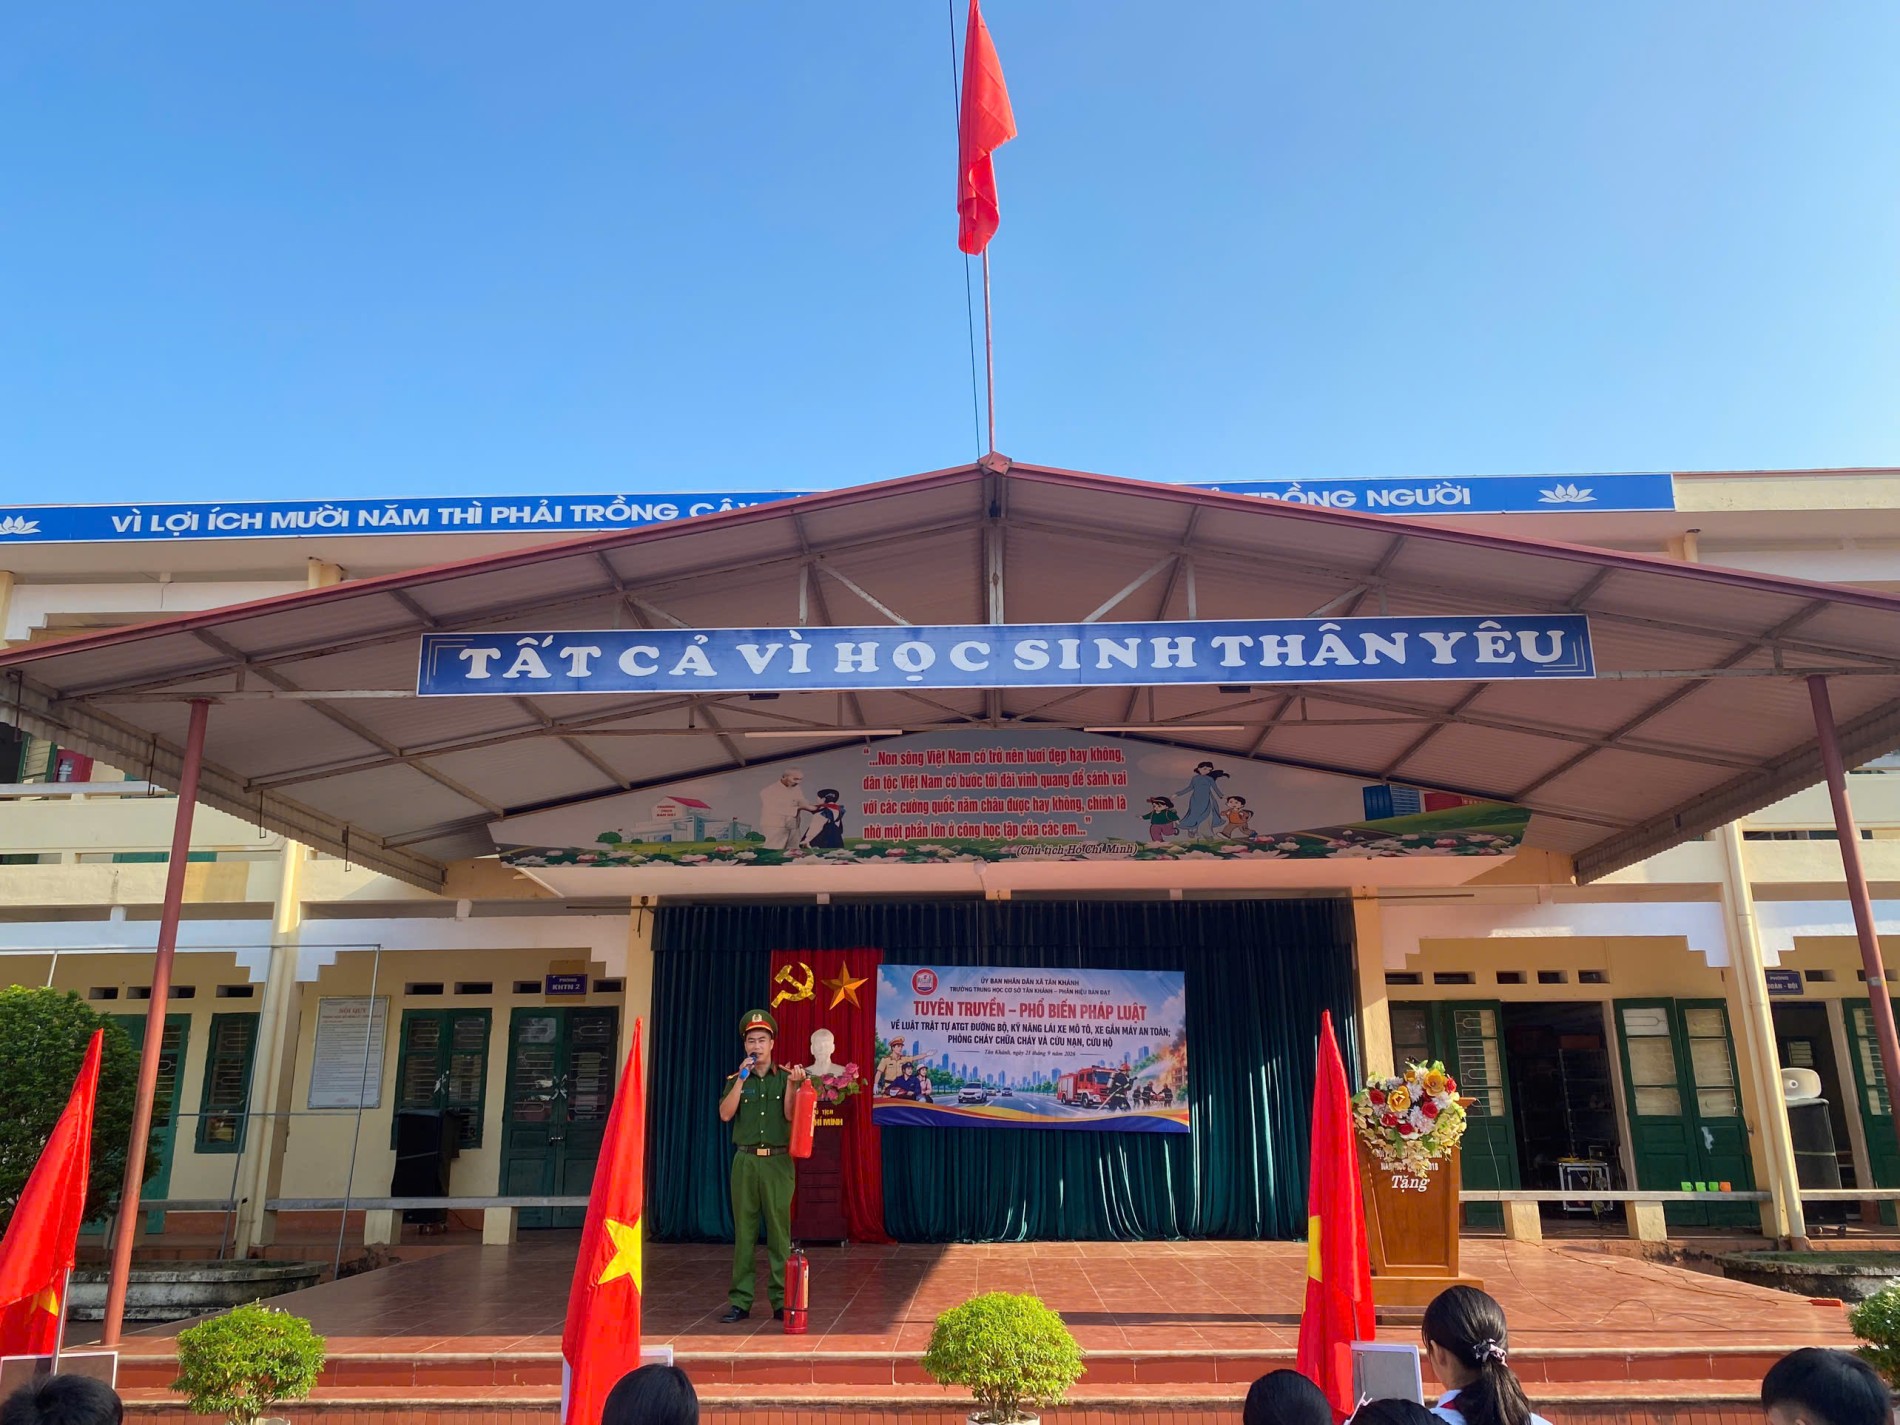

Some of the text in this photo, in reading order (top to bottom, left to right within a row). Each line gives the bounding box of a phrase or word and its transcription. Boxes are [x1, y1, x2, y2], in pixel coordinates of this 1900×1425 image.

[1367, 481, 1470, 506] NGƯỜI
[112, 508, 142, 533] VÌ
[151, 511, 199, 536] LỢI
[208, 507, 262, 530] ÍCH
[271, 505, 348, 528] MƯỜI
[358, 504, 429, 527] NĂM
[438, 501, 482, 524] THÌ
[491, 499, 562, 523] PHẢI
[570, 495, 679, 522] TRỒNG
[459, 620, 1564, 681] TẤT CẢ VÌ HỌC SINH THÂN YÊU
[900, 751, 924, 766] sông
[927, 750, 945, 767] Việt
[948, 750, 970, 764] Nam
[974, 749, 986, 763] có
[989, 747, 1002, 763] trở
[1006, 749, 1023, 763] nên
[1027, 748, 1045, 763] tươi
[1049, 748, 1066, 766] đẹp
[1070, 748, 1087, 763] hay
[1090, 747, 1125, 763] không,
[863, 768, 1127, 792] dân tộc Việt Nam có bước tới đài vinh quang để sánh vai
[863, 794, 1126, 815] với các cường quốc năm châu được hay không, chính là
[864, 825, 881, 839] nhờ
[884, 824, 902, 842] một
[905, 820, 928, 840] phần
[931, 822, 945, 838] lớn
[948, 820, 955, 838] ở
[957, 821, 980, 838] công
[983, 821, 1000, 841] học
[1003, 821, 1018, 840] tập
[1021, 820, 1039, 837] của
[1042, 822, 1059, 836] các
[1022, 977, 1034, 985] DÂN
[1045, 978, 1056, 986] TÂN
[913, 998, 953, 1016] TUYÊN
[957, 997, 1005, 1018] TRUYỀN
[1020, 998, 1044, 1018] PHỔ
[1048, 999, 1076, 1019] BIẾN
[1080, 1002, 1113, 1020] PHÁP
[1117, 1002, 1147, 1024] LUẬT
[901, 1020, 919, 1032] LUẬT
[921, 1020, 939, 1032] TRẬT
[940, 1021, 950, 1032] TỰ
[952, 1022, 969, 1031] ATGT
[971, 1021, 995, 1032] ĐƯỜNG
[997, 1021, 1009, 1034] BỘ,
[1044, 1023, 1056, 1033] LÁI
[1057, 1025, 1067, 1033] XE
[1069, 1023, 1080, 1034] MÔ
[1082, 1024, 1093, 1035] TÔ,
[1095, 1026, 1104, 1034] XE
[1122, 1025, 1137, 1035] MÁY
[1139, 1027, 1148, 1036] AN
[1150, 1026, 1171, 1037] TOÀN;
[948, 1034, 1113, 1049] PHÒNG CHÁY CHỮA CHÁY VÀ CỨU NẠN, CỨU HỘ
[823, 1118, 843, 1126] MINH
[1391, 1175, 1430, 1193] Tặng
